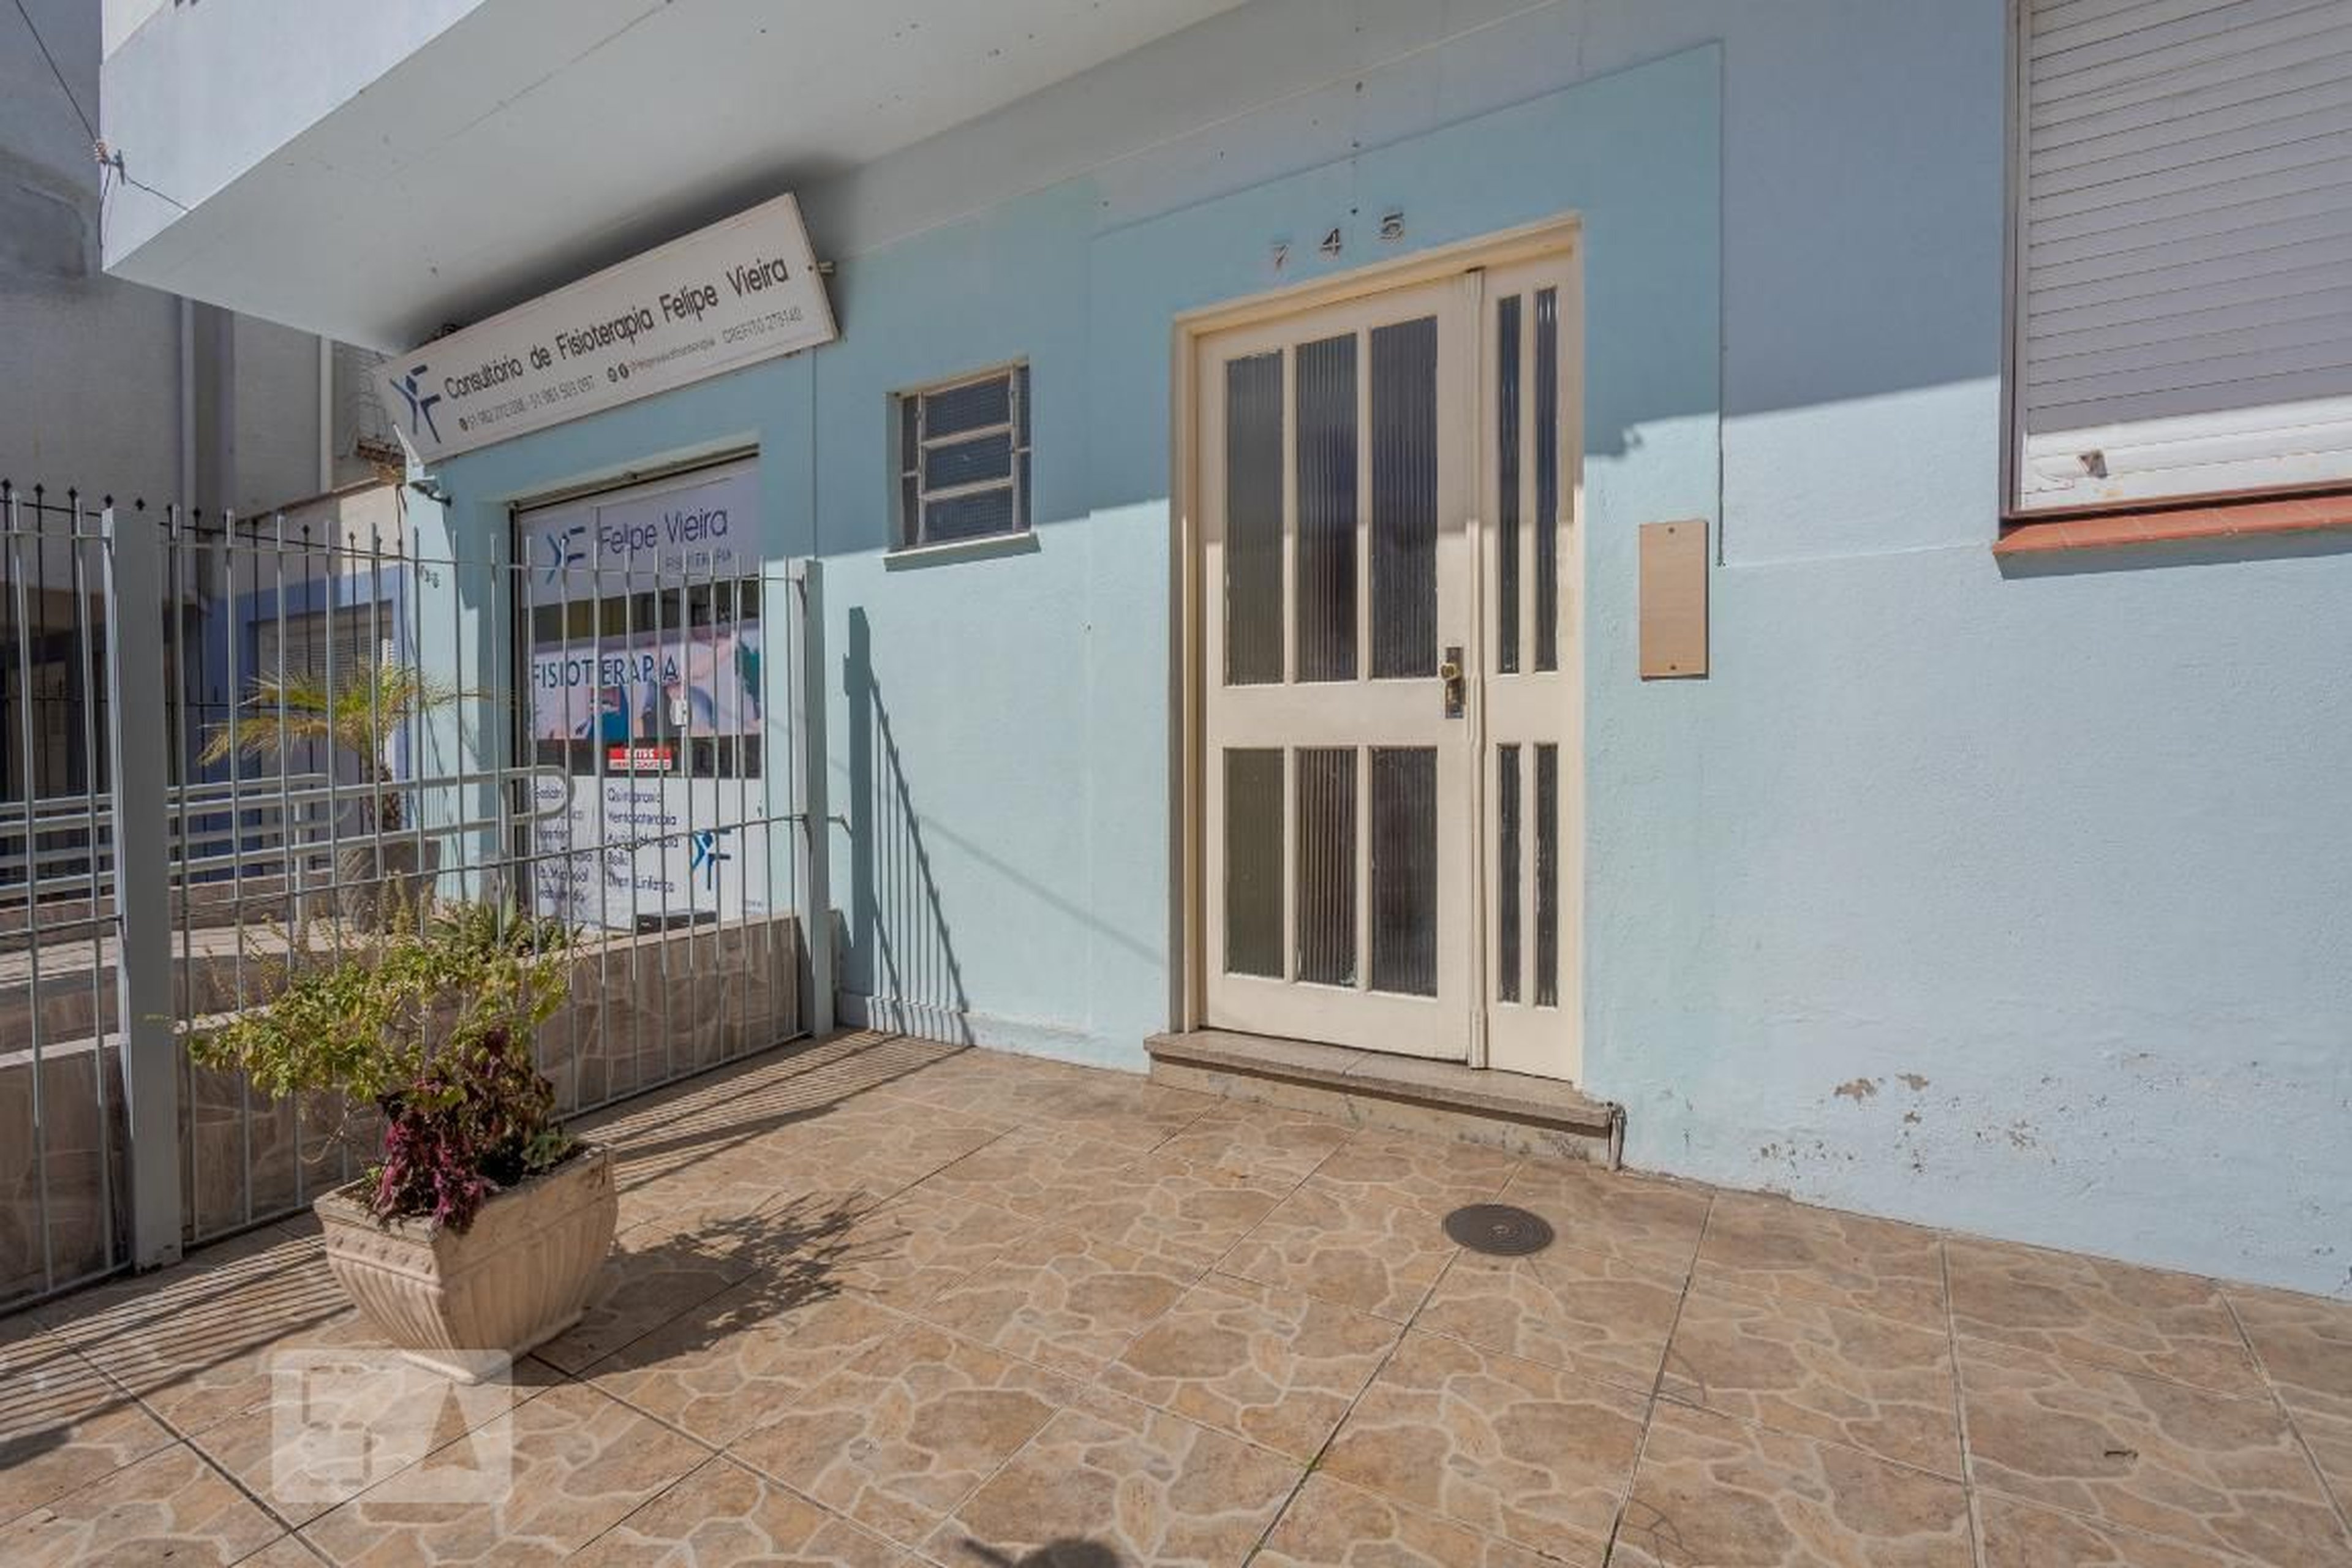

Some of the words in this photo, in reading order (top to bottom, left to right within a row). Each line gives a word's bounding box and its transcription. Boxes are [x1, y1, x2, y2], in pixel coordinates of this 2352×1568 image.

[1270, 212, 1405, 270] 745
[444, 355, 524, 399] Consultório
[530, 343, 552, 370] de
[556, 306, 655, 360] Fisioterapia
[658, 285, 719, 323] Felipe
[726, 258, 790, 298] Vieira
[665, 508, 727, 544] Vieira
[532, 655, 679, 688] FISIOTERAPA
